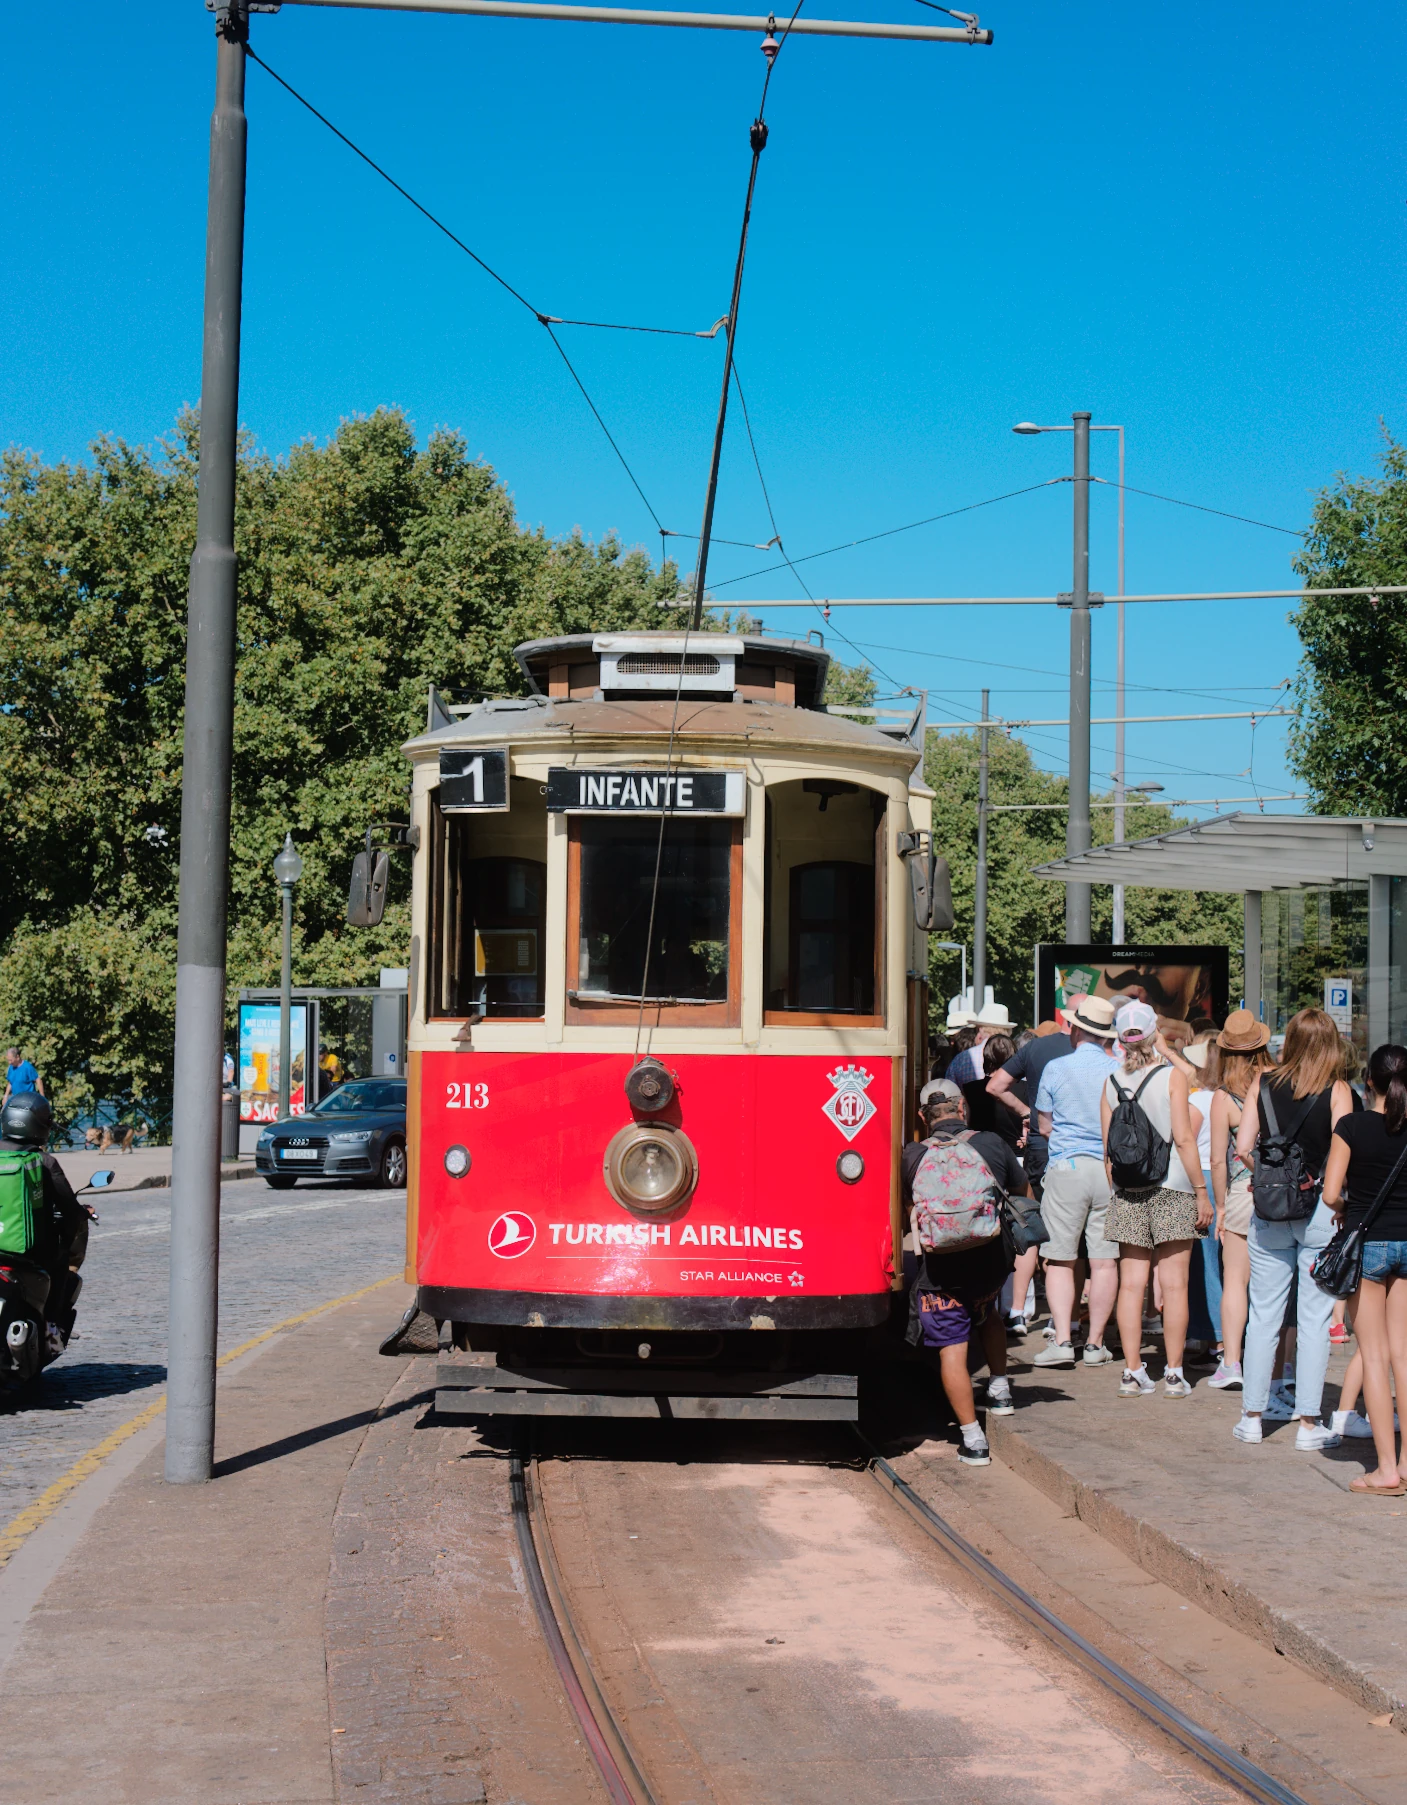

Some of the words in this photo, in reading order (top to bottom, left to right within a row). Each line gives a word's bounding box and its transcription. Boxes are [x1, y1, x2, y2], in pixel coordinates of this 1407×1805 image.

[462, 756, 485, 803] 1
[579, 776, 694, 807] INFANTE
[446, 1082, 490, 1109] 213
[253, 1100, 305, 1121] SAGES
[549, 1224, 671, 1245] TURKISH
[679, 1225, 804, 1249] AIRLINES
[680, 1271, 714, 1281] STAR
[718, 1271, 782, 1283] ALLIANCE
